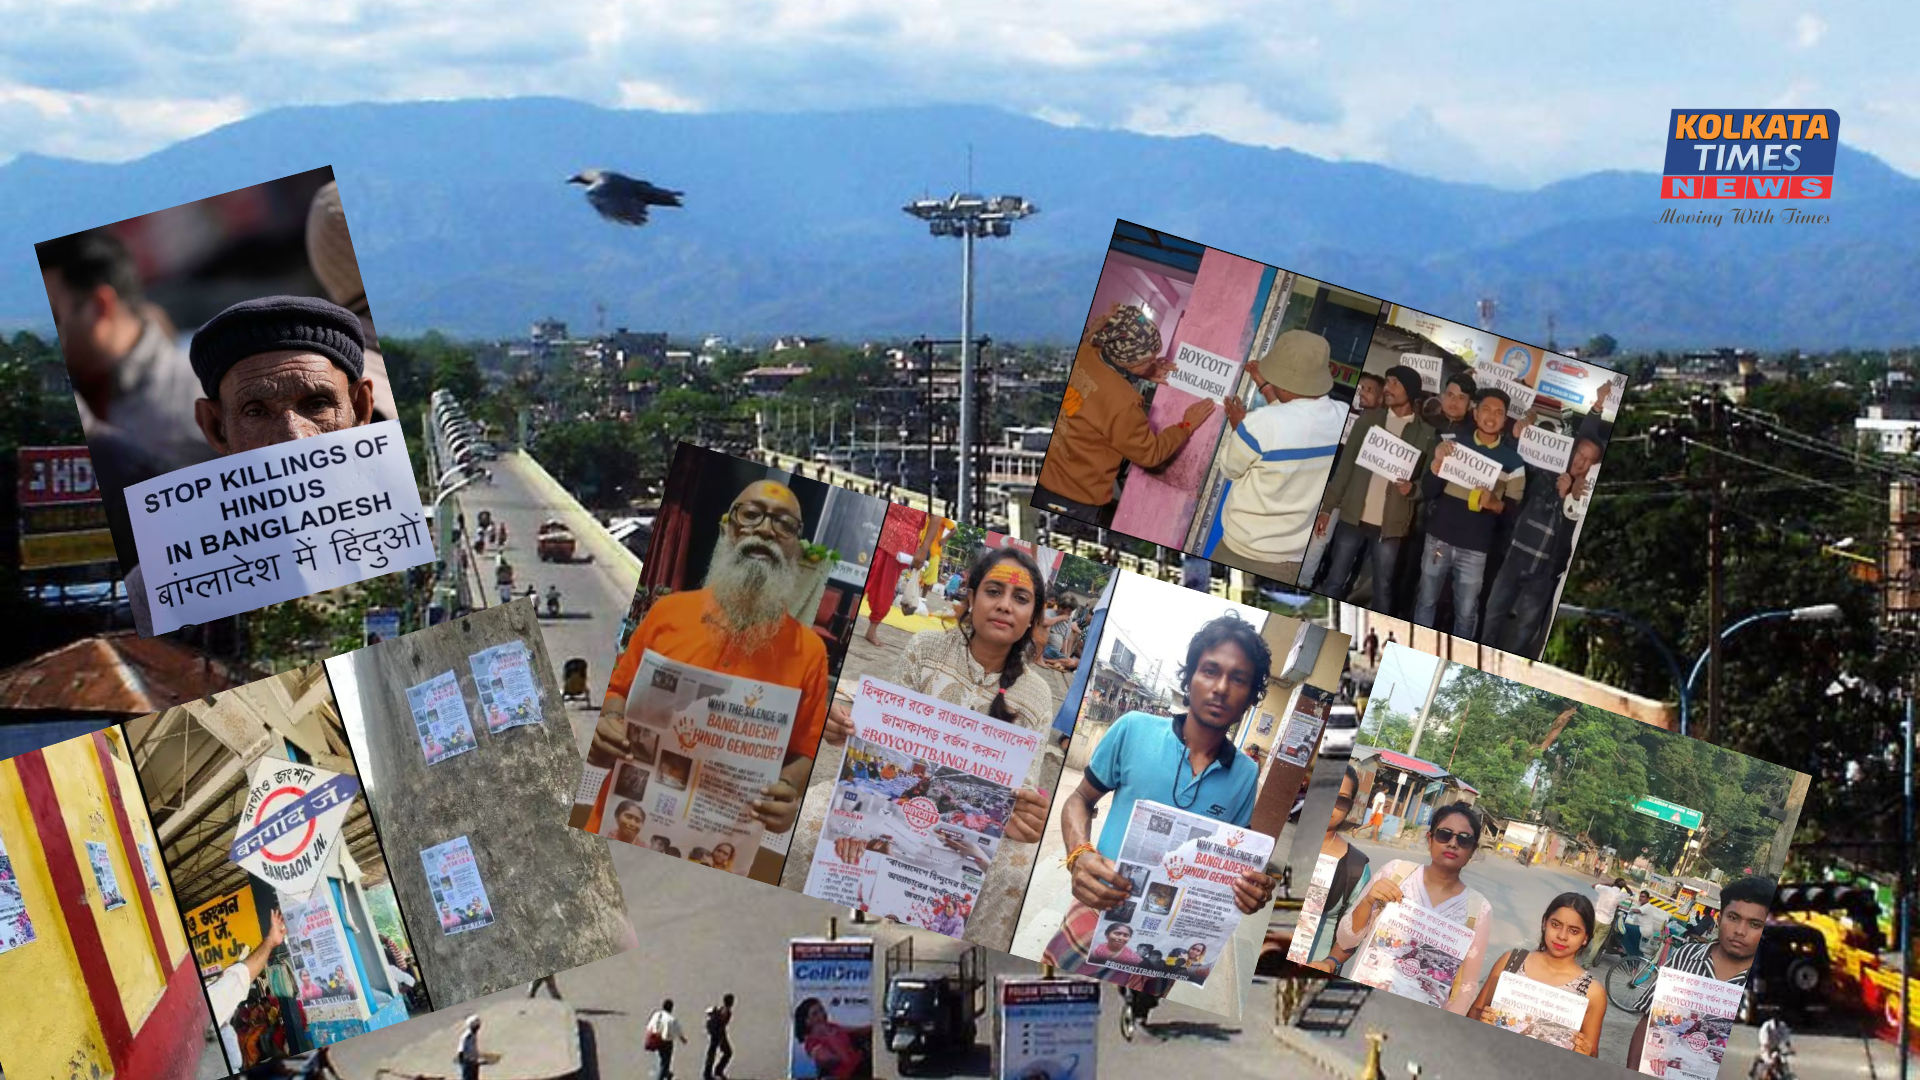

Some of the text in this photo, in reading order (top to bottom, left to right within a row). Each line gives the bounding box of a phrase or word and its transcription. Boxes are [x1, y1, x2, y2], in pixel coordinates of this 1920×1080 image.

[1178, 346, 1233, 377] BOYCOTT
[1401, 356, 1440, 372] BOYCOTT
[1478, 361, 1515, 381] BOYCOTT
[1171, 369, 1226, 397] BANGLADESH
[1495, 379, 1533, 403] BOYCOTT
[1368, 432, 1416, 463] BOYCOTT
[1524, 427, 1570, 452] BOYCOTT
[1361, 450, 1410, 480] BANGLADESH
[1450, 447, 1497, 478] BOYCOTT
[1519, 444, 1565, 468] BANGLADESH
[144, 435, 389, 514] STOP KILLINGS OF
[1443, 463, 1490, 490] BANGLADESH
[220, 479, 326, 521] HINDUS
[166, 492, 392, 565] IN BANGLADESH
[155, 512, 421, 608] बांग्लादेश में हिंदुओं
[707, 698, 727, 713] WHY
[728, 702, 744, 716] THE
[776, 712, 789, 724] ON
[861, 680, 1038, 752] হিন্দুদের রক্তে রাঙানো বাংলাদেশী
[706, 713, 780, 741] BANGLADESHI
[881, 712, 1007, 763] জামাকাপড় বর্জন করুন!
[693, 728, 784, 761] HINDU GENOCIDE?
[861, 727, 1014, 786] #BOYCOTTBANGLADESH
[273, 767, 316, 786] জংশন
[904, 803, 940, 824] BOYCOTT
[235, 804, 307, 856] बनगांव
[262, 833, 328, 881] BANGAON JN.
[1196, 839, 1264, 866] WHY THE SILENCE ON
[1181, 864, 1208, 880] HINDU
[960, 881, 978, 895] উপর
[1387, 918, 1461, 957] #BOYCOTTBANGLADESH
[795, 963, 869, 982] CellOne
[1104, 959, 1189, 982] #BOYCOTTBANGLADESH
